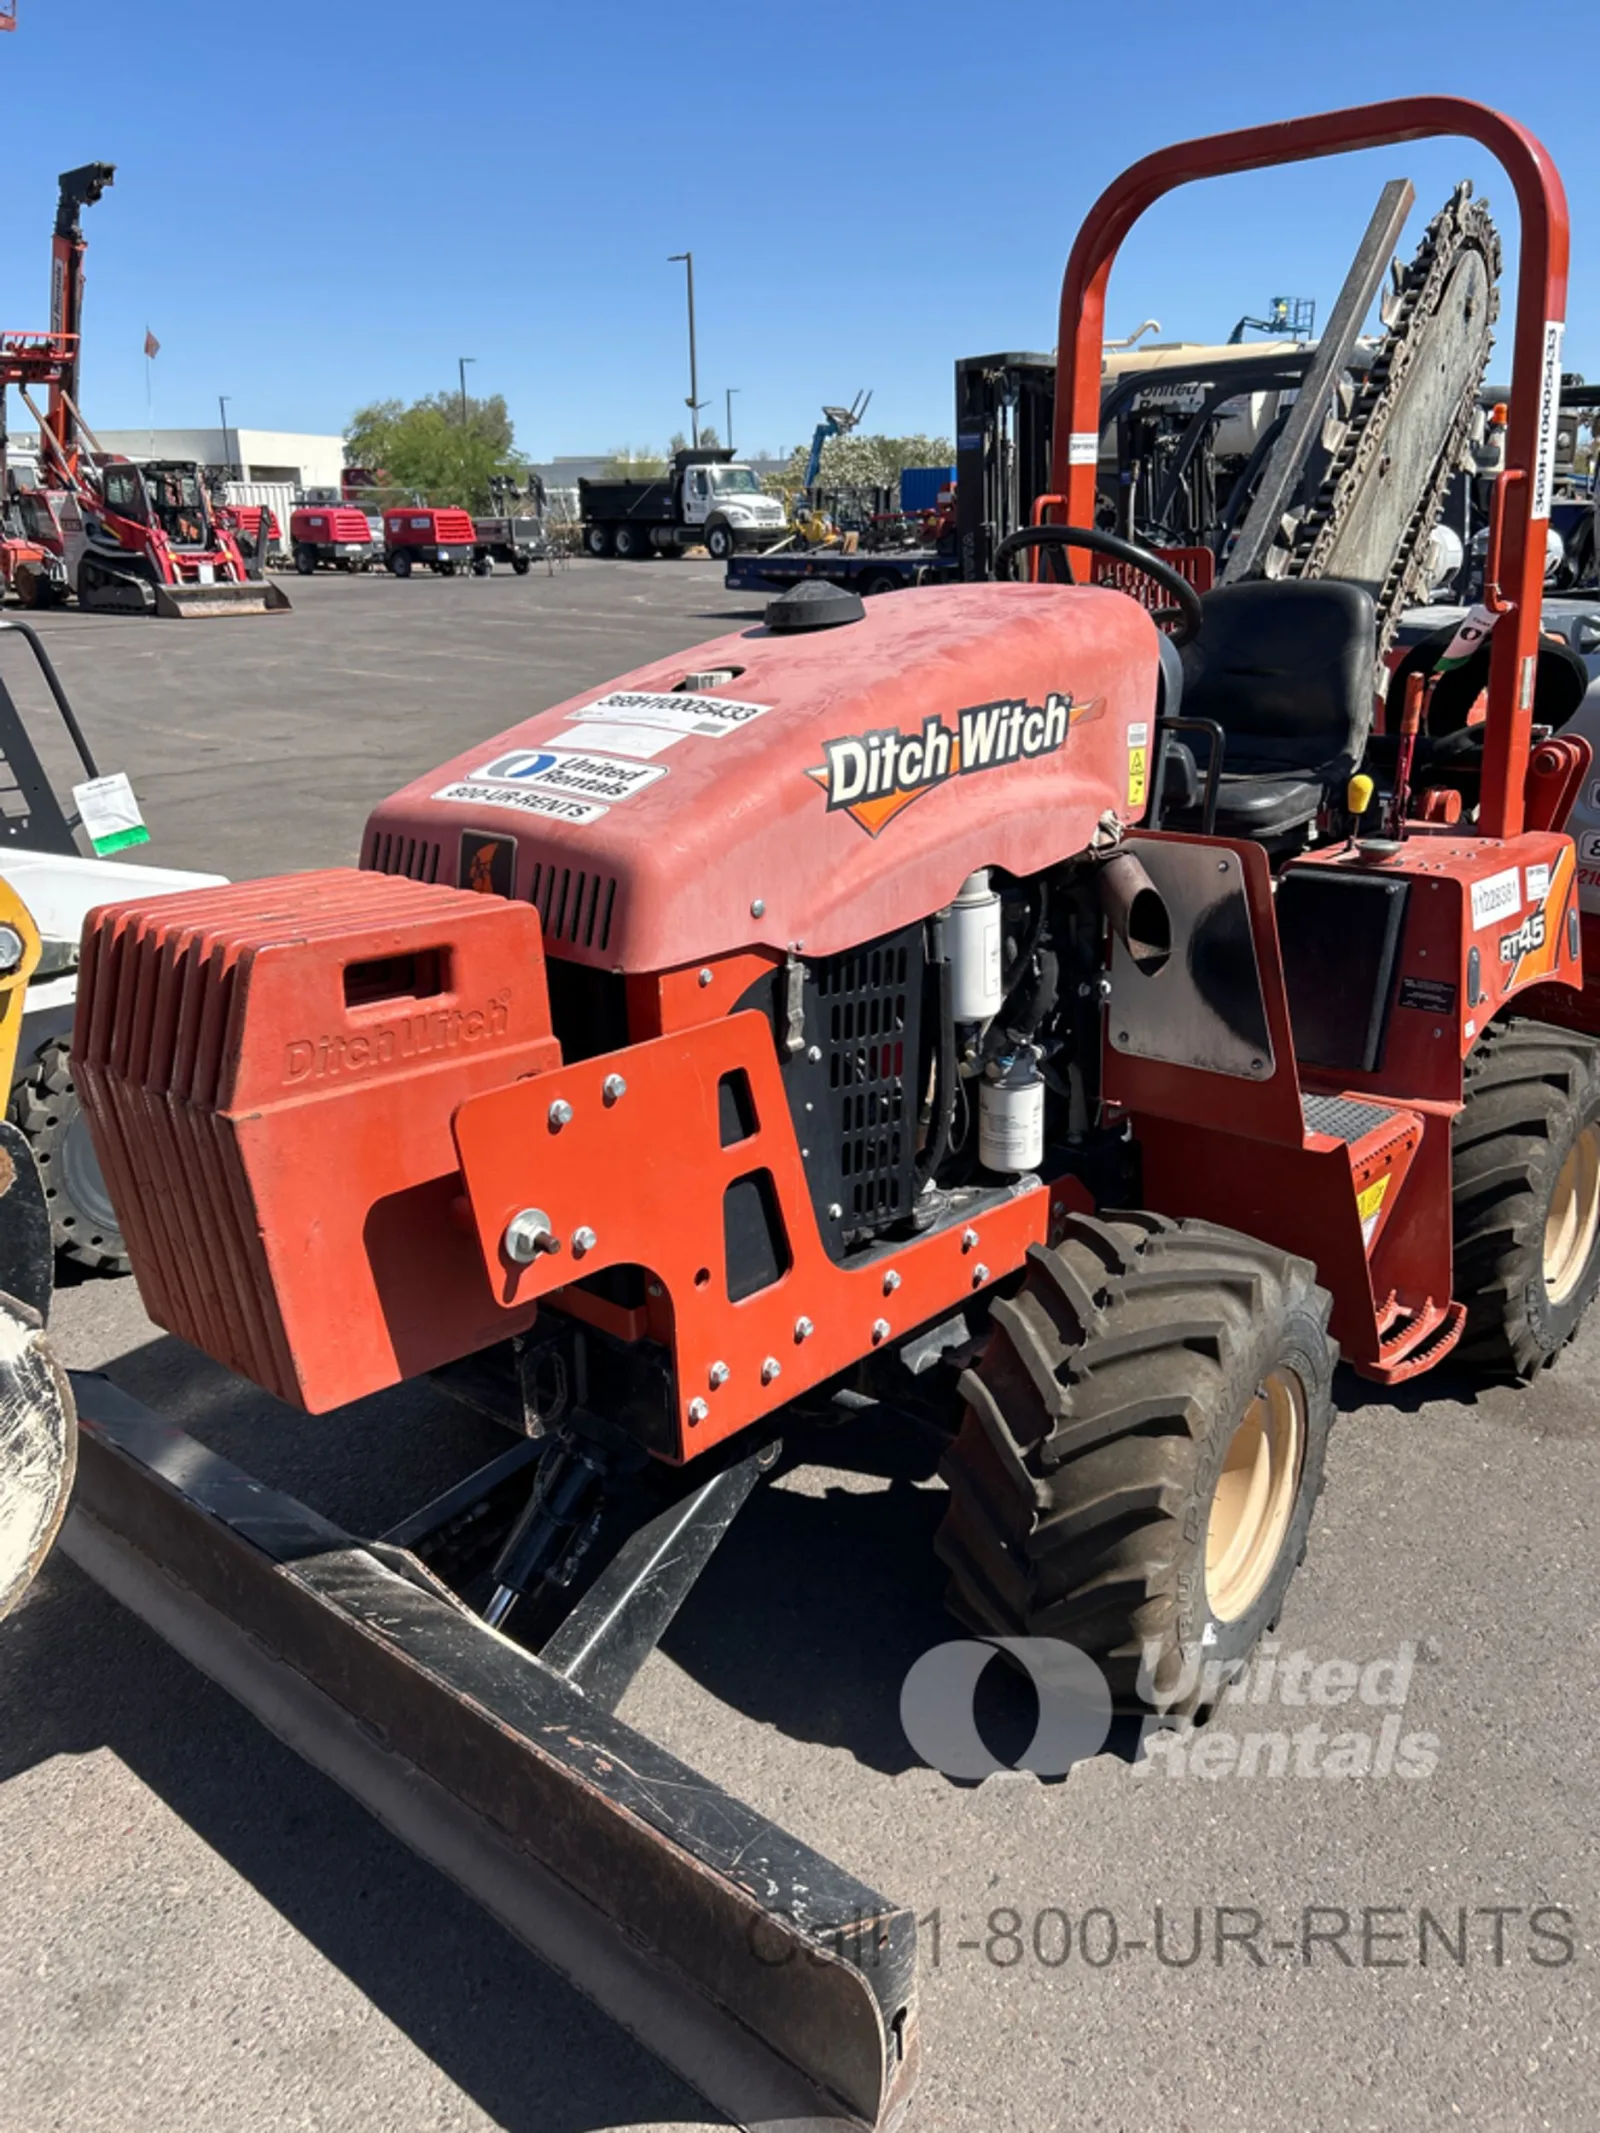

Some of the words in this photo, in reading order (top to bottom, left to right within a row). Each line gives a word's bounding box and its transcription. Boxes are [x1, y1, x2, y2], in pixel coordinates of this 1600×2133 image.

[1535, 329, 1557, 513] 369H10005433
[558, 757, 647, 783] United
[827, 719, 951, 806] Ditch
[959, 693, 1071, 770] Witch
[447, 786, 591, 817] 800-UR-RENTS
[536, 769, 629, 797] Rentals
[1500, 913, 1545, 963] RT45
[282, 1023, 395, 1086] Ditch
